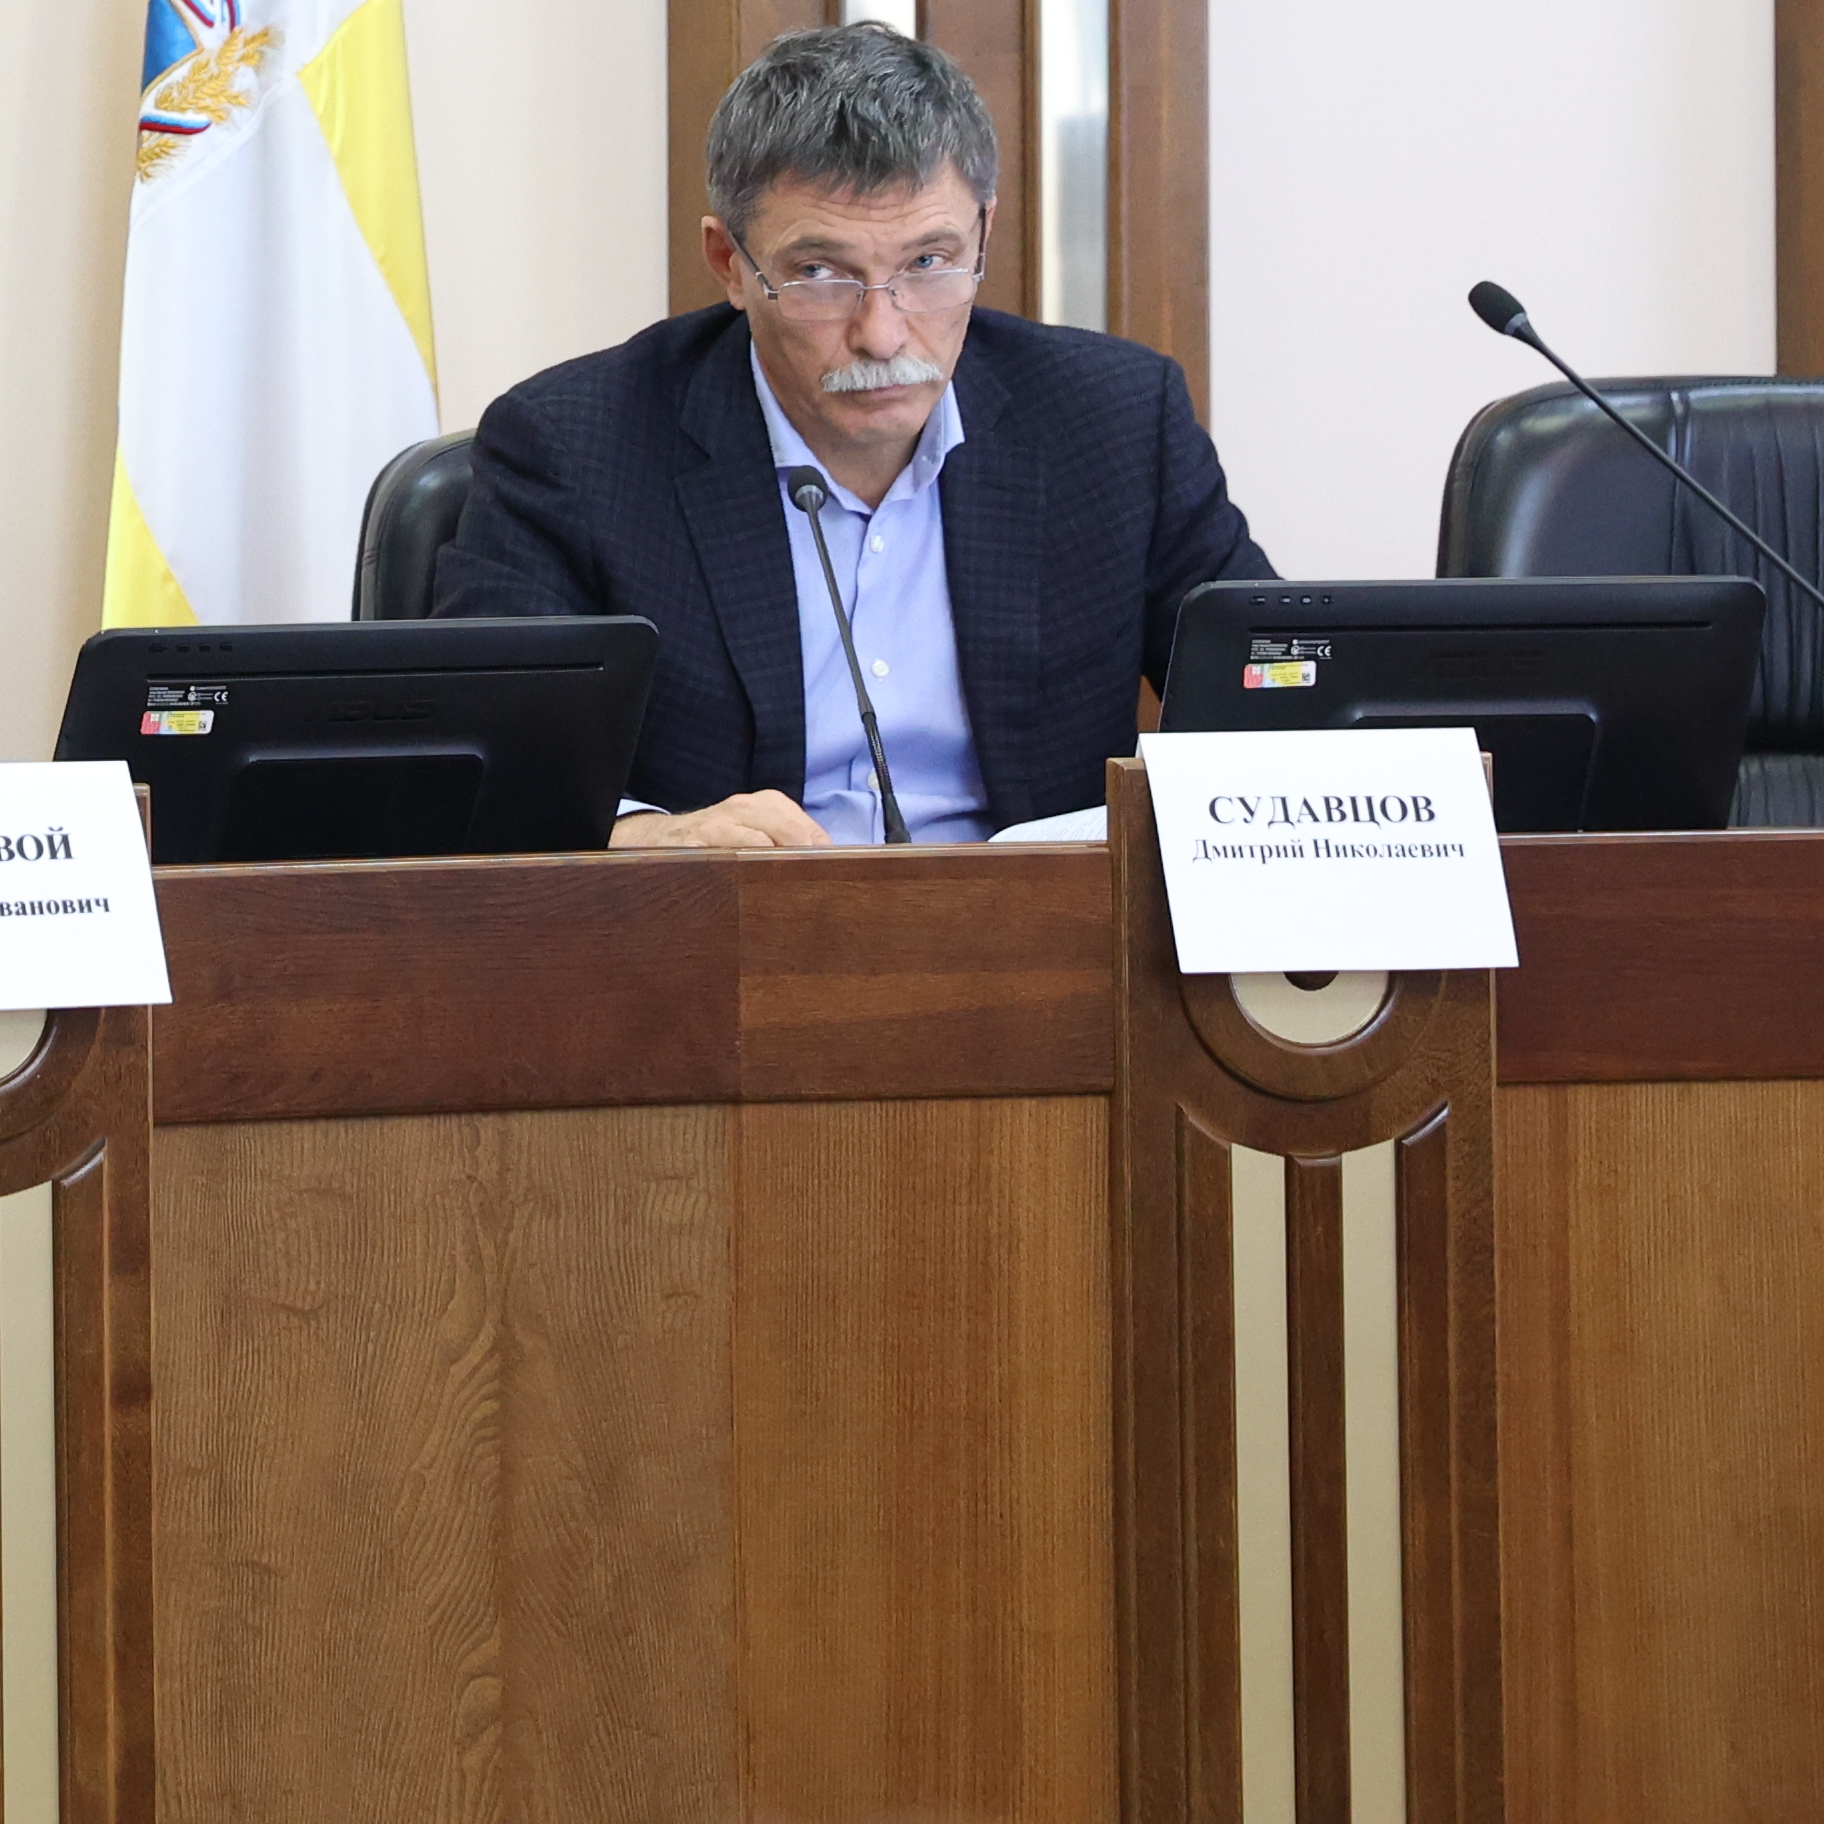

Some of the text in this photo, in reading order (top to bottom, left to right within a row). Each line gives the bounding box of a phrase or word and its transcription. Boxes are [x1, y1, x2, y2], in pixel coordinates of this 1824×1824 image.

[1208, 795, 1436, 829] СУДАВЦОВ
[1192, 837, 1466, 864] Дмитрий Николаевич
